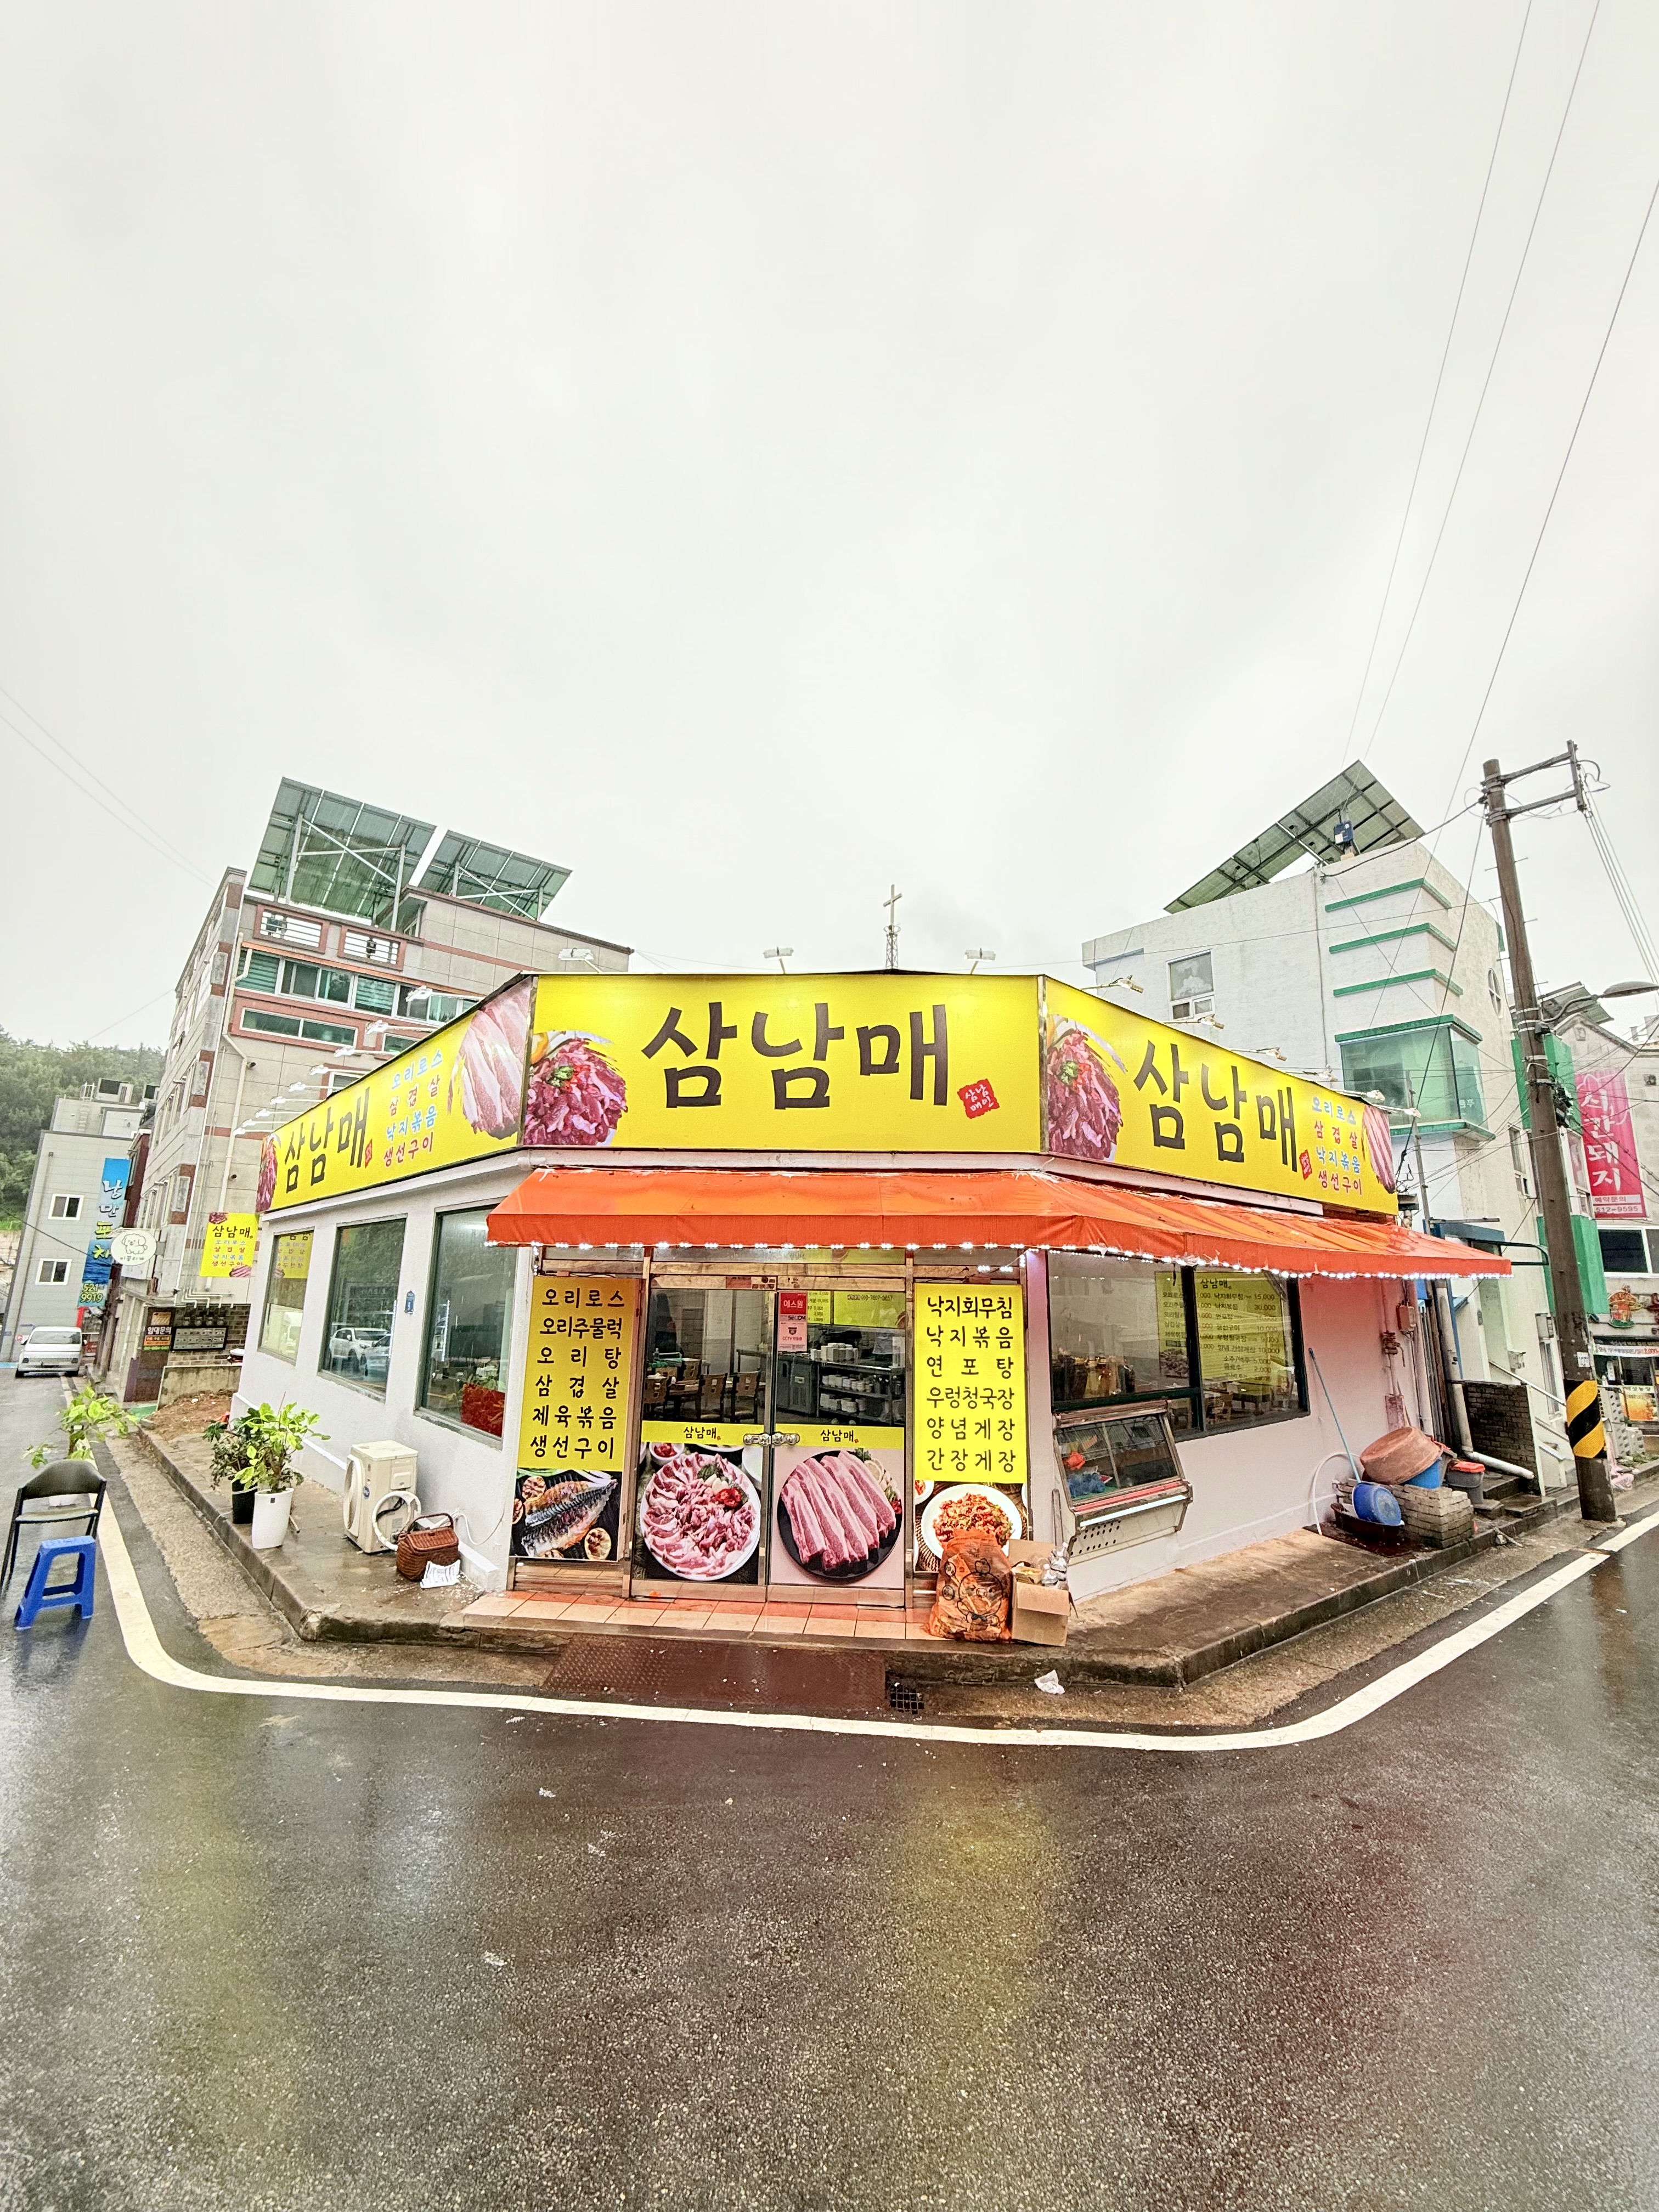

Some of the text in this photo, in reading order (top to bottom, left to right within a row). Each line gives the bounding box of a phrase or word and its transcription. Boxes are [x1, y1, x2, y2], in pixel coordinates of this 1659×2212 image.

[641, 1002, 948, 1110] 삼남매
[391, 1049, 442, 1090] 오리로스
[390, 1074, 441, 1117] 삼겹살
[1133, 1040, 1297, 1172] 삼남매
[386, 1104, 437, 1142] 낙지볶음
[1312, 1097, 1356, 1125] 오리로스
[284, 1087, 370, 1194] 삼남매
[1314, 1120, 1357, 1149] 삼겹살
[383, 1132, 433, 1167] 생선구이
[1316, 1147, 1359, 1173] 낙지볶음
[1318, 1170, 1362, 1195] 생선구이
[212, 1226, 251, 1238] 삼남매
[1200, 1278, 1228, 1289] 삼남매
[81, 1293, 103, 1302] 9919
[542, 1288, 625, 1308] 오리로스
[783, 1300, 803, 1308] 에스원
[927, 1295, 1012, 1319] 낙지회무침
[148, 1326, 172, 1335] 임대문의
[540, 1317, 622, 1340] 오리주물럭
[927, 1325, 1013, 1349] 낙지볶음
[537, 1346, 622, 1369] 오리탕
[927, 1355, 1014, 1379] 연포탕
[535, 1374, 619, 1399] 삼겹살
[926, 1386, 1015, 1410] 우렁청국장
[532, 1404, 617, 1430] 제육볶음
[927, 1416, 1015, 1441] 양념게장
[684, 1426, 717, 1440] 삼남매
[820, 1429, 855, 1443] 삼남매
[530, 1435, 613, 1459] 생선구이
[927, 1447, 1016, 1473] 간장게장
